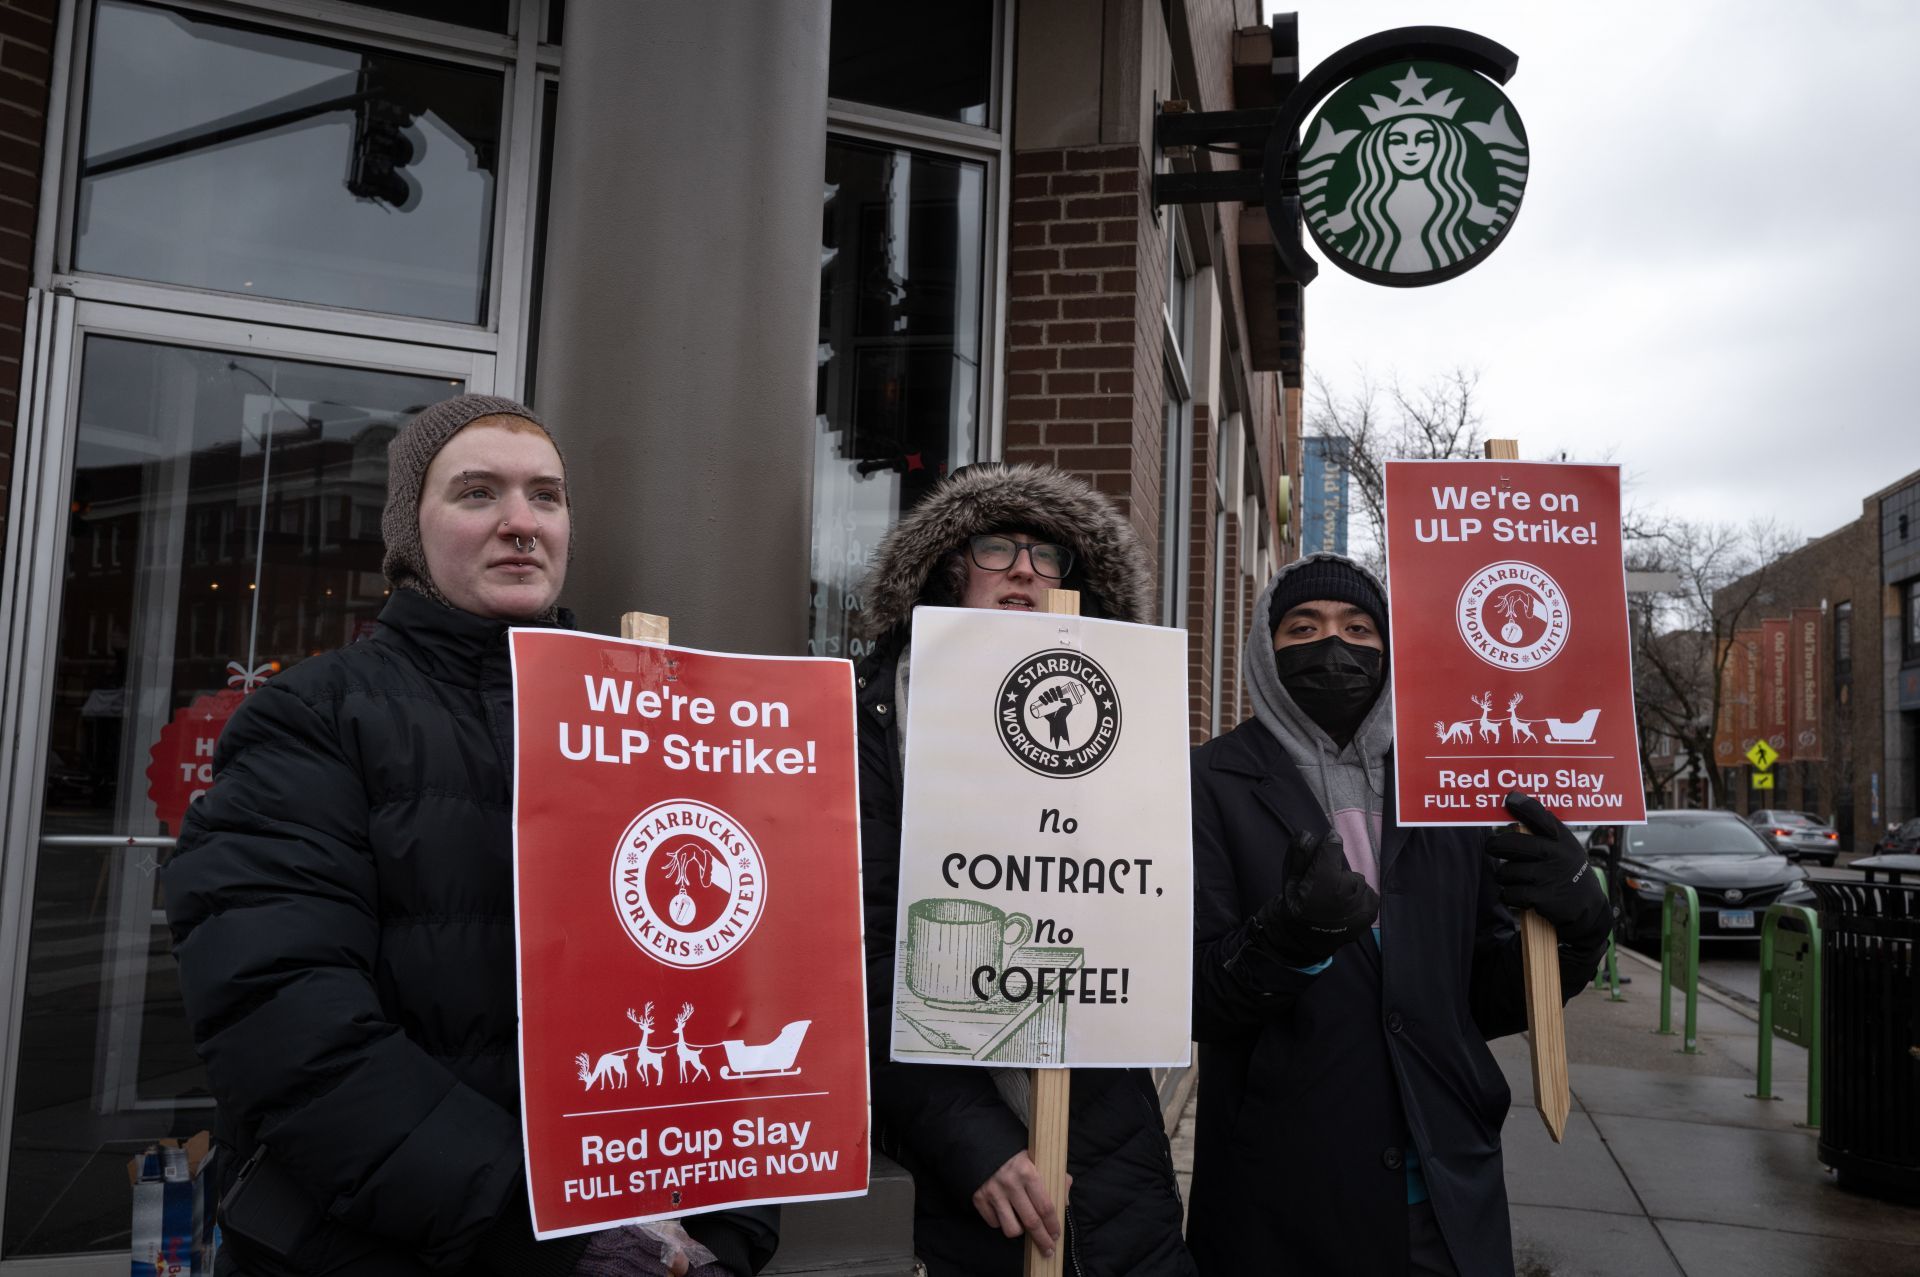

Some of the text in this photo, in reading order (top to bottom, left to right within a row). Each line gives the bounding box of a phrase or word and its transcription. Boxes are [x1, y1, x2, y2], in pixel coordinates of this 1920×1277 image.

[1431, 486, 1579, 513] We're on
[1415, 517, 1598, 545] ULP Strike!
[1471, 568, 1555, 599] STARBUCKS
[849, 638, 877, 657] an
[1465, 606, 1563, 664] WORKERS UNITED
[1017, 658, 1107, 696] STARBUCKS
[1805, 622, 1816, 720] Old Town School
[584, 674, 789, 728] We're on
[195, 738, 215, 757] H
[559, 721, 817, 775] ULP Strike!
[1002, 707, 1114, 768] WORKERS UNITED
[179, 763, 214, 783] TO
[1439, 769, 1604, 793] Red Cup Slay
[1424, 793, 1623, 809] FULL STING NOW
[633, 810, 745, 857] STARBUCKS
[1039, 808, 1078, 834] no
[941, 852, 1163, 897] CONTRACT,
[624, 867, 755, 958] WORKERS UNITED
[1034, 918, 1074, 945] no
[971, 965, 1130, 1005] COFFEE!
[581, 1117, 812, 1166] Red Cup Slay
[564, 1150, 839, 1203] FULL STAFFING NOW
